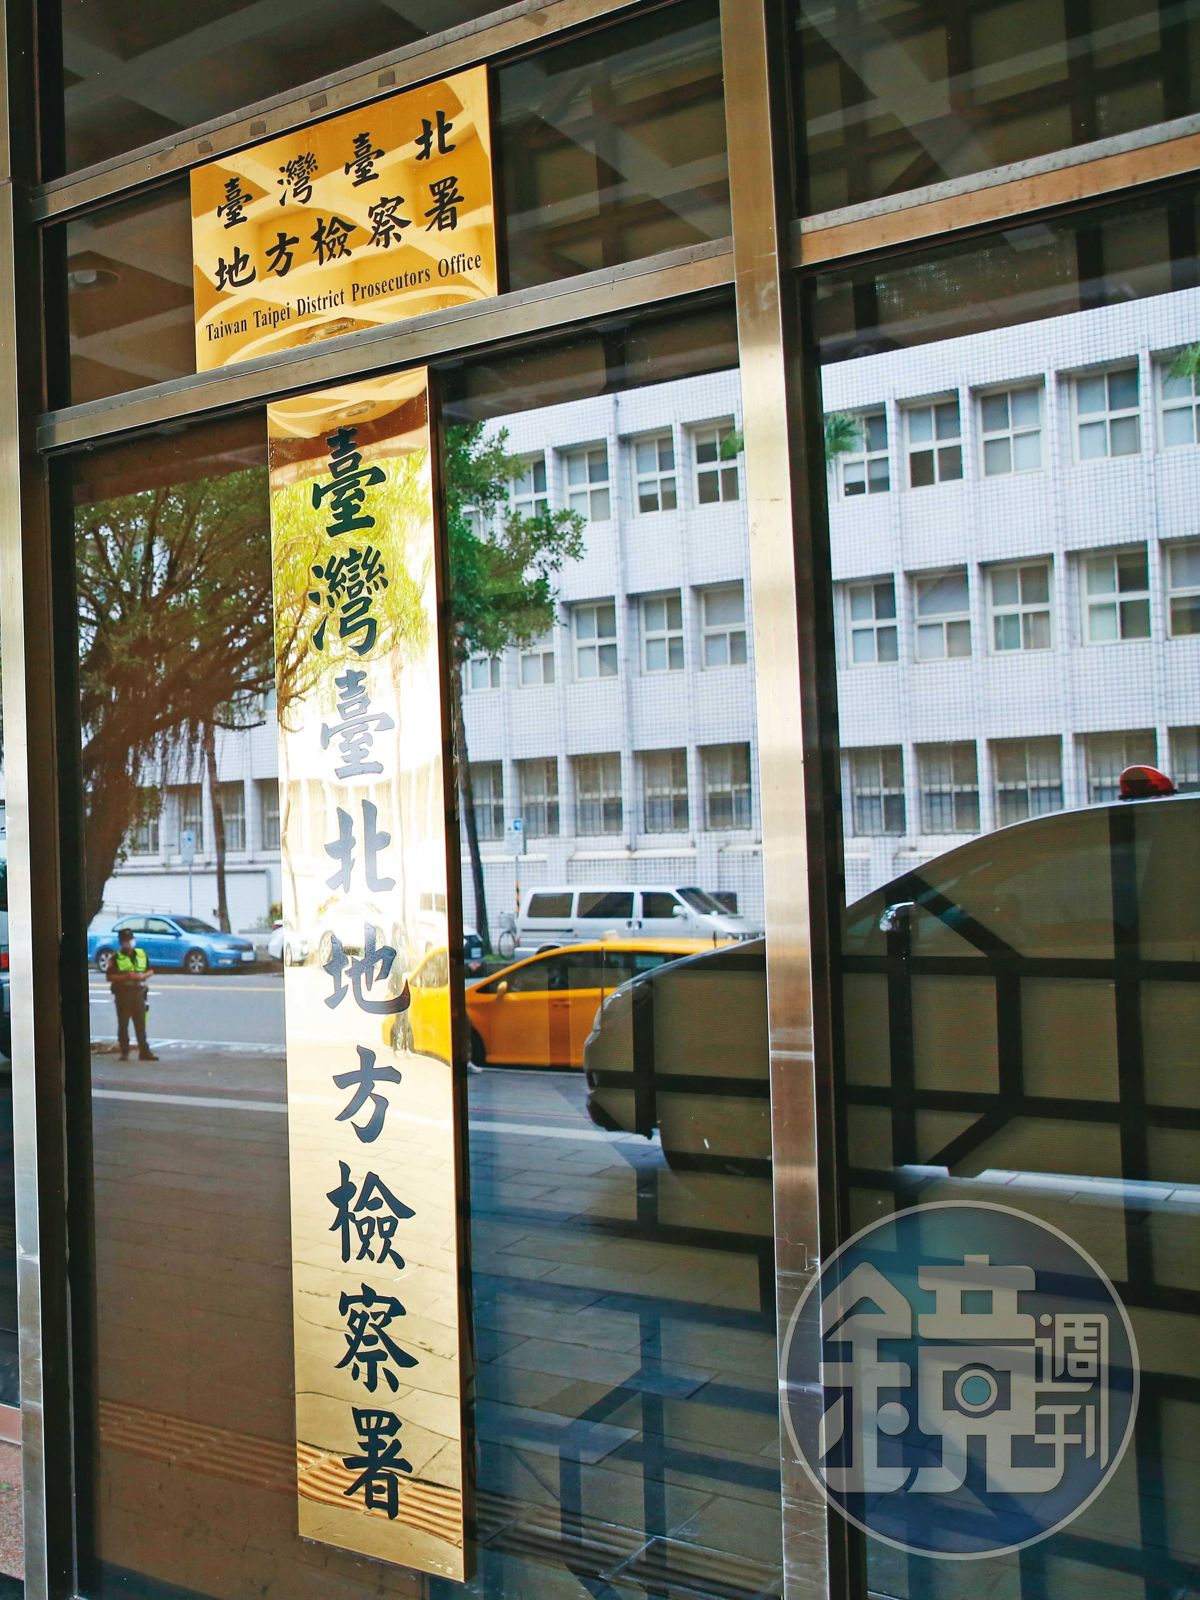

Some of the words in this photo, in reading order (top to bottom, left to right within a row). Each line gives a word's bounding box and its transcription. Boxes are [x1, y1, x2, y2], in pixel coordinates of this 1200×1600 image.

[216, 110, 457, 230] 臺灣臺北
[215, 176, 465, 292] 地方檢察署
[206, 318, 248, 342] Taiwan
[253, 302, 291, 330] Taipei
[297, 288, 345, 317] District
[351, 267, 431, 302] Prosecutors
[438, 254, 482, 278] Office
[308, 426, 420, 1520] 臺灣臺北地方檢察署
